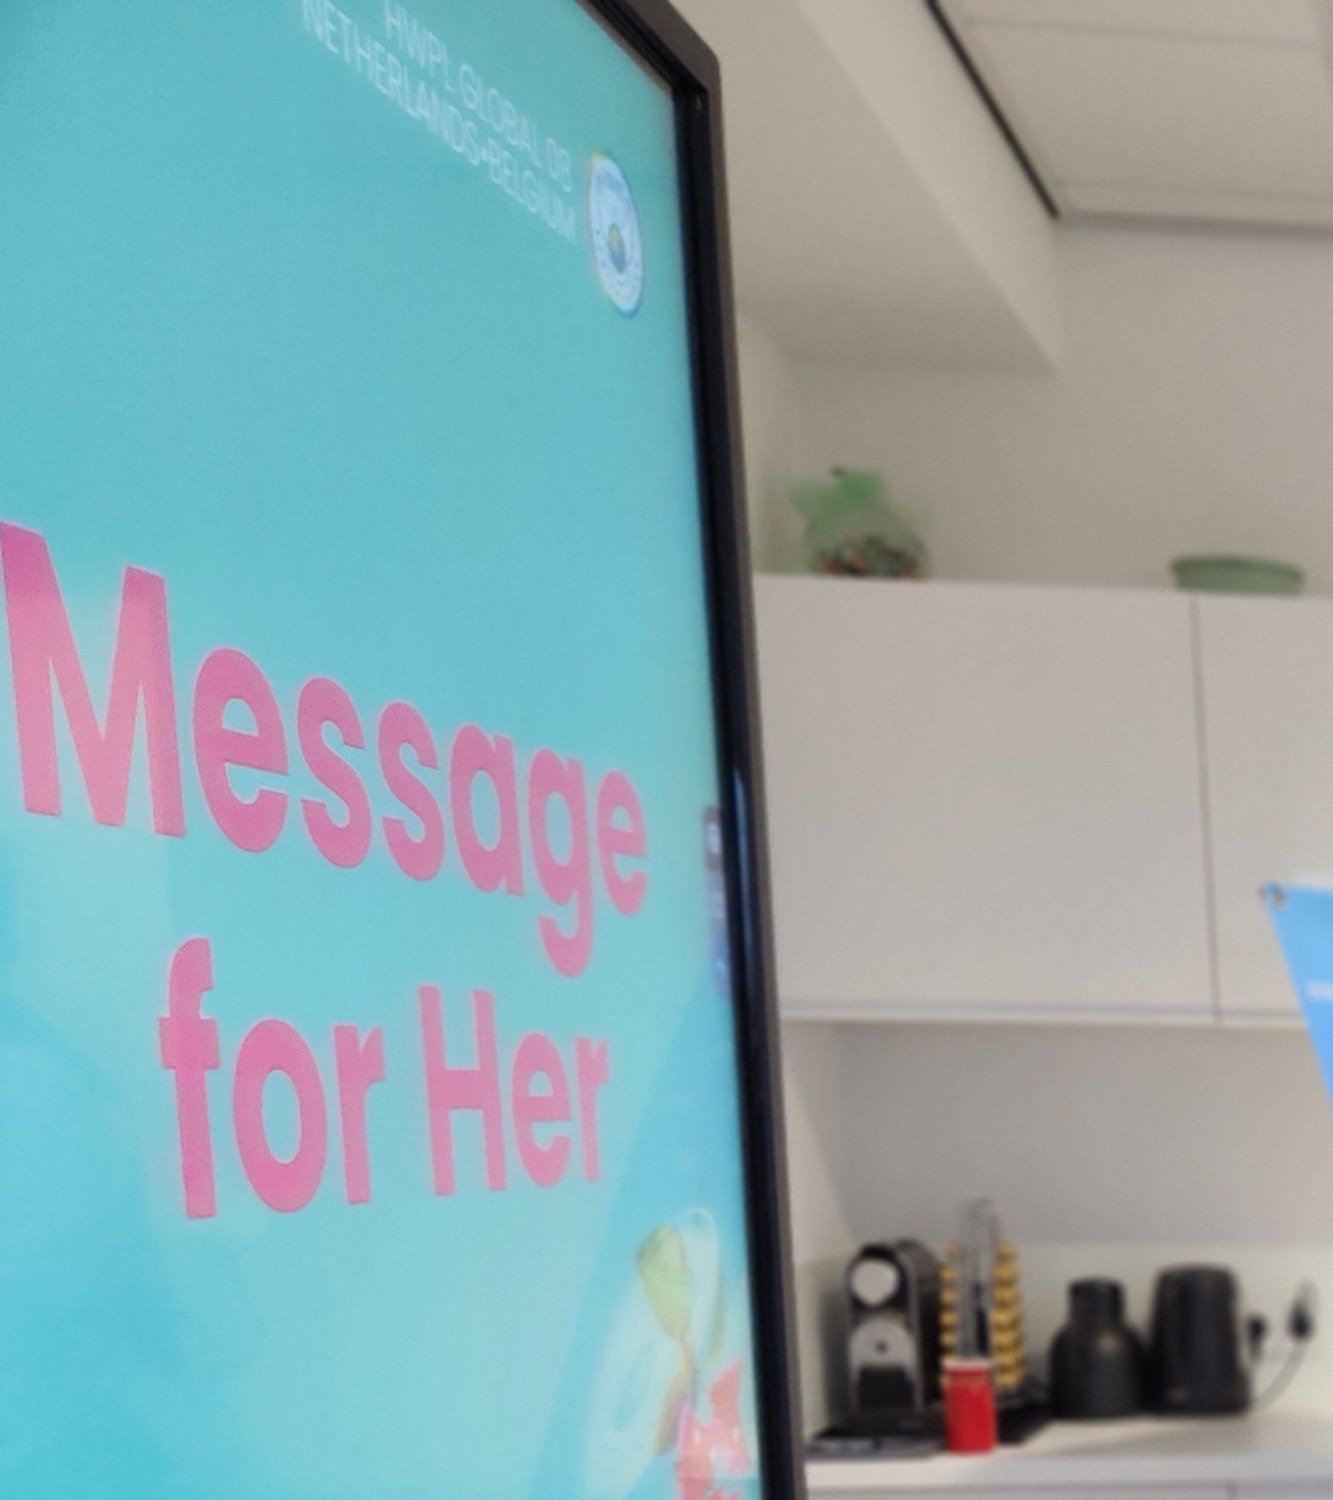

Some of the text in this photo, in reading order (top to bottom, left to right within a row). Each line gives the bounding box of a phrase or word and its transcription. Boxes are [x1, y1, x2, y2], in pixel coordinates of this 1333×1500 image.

[458, 62, 543, 169] GLOBAL
[0, 522, 649, 978] Message
[157, 936, 609, 1220] for Her
